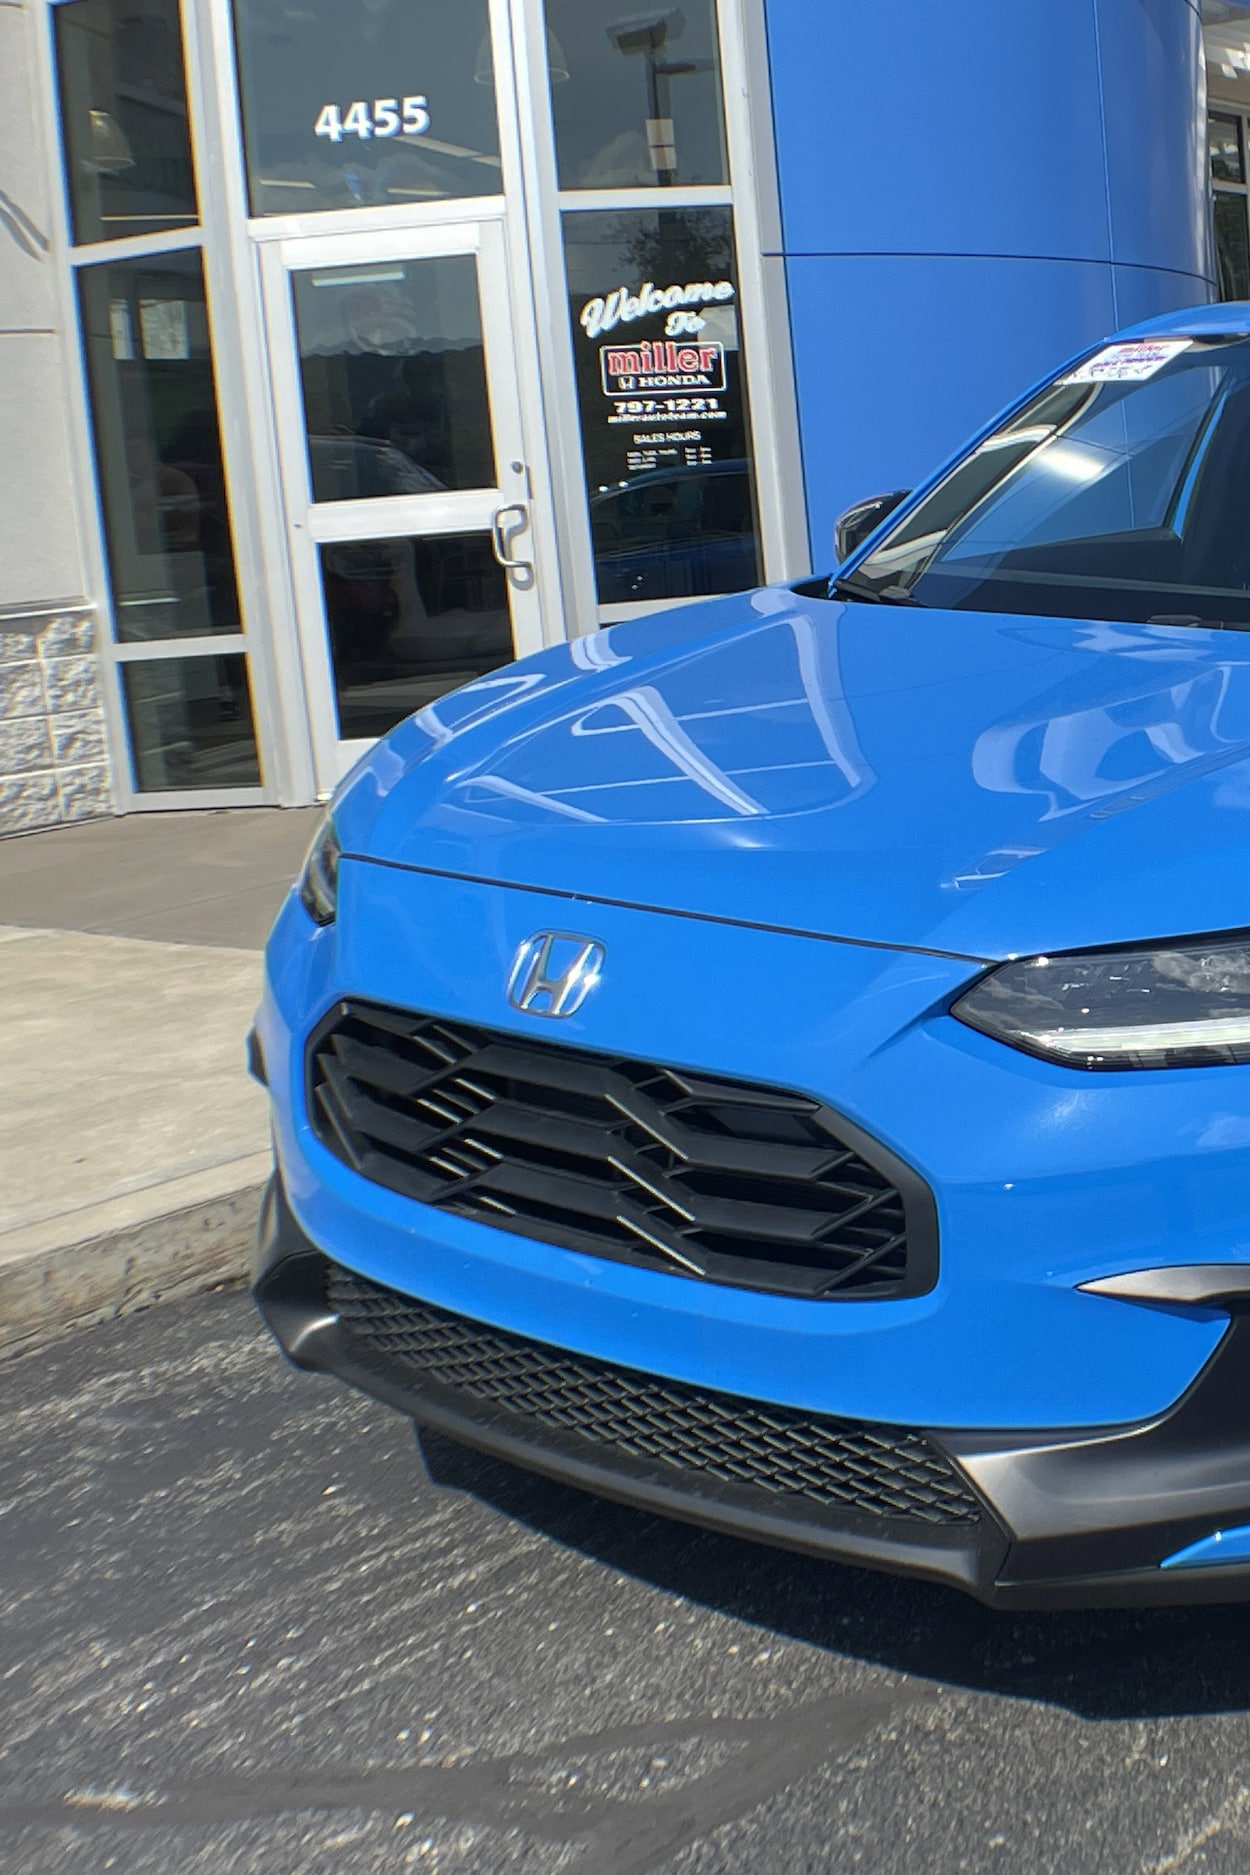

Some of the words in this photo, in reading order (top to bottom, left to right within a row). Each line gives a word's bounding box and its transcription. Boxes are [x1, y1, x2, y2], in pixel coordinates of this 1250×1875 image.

[314, 95, 431, 143] 4455
[580, 281, 736, 339] Welcome
[664, 311, 707, 337] To
[607, 341, 718, 376] miller
[638, 374, 712, 388] HONDA
[613, 398, 719, 414] 797-1221
[633, 431, 665, 445] SALES
[665, 428, 702, 442] HOURS
